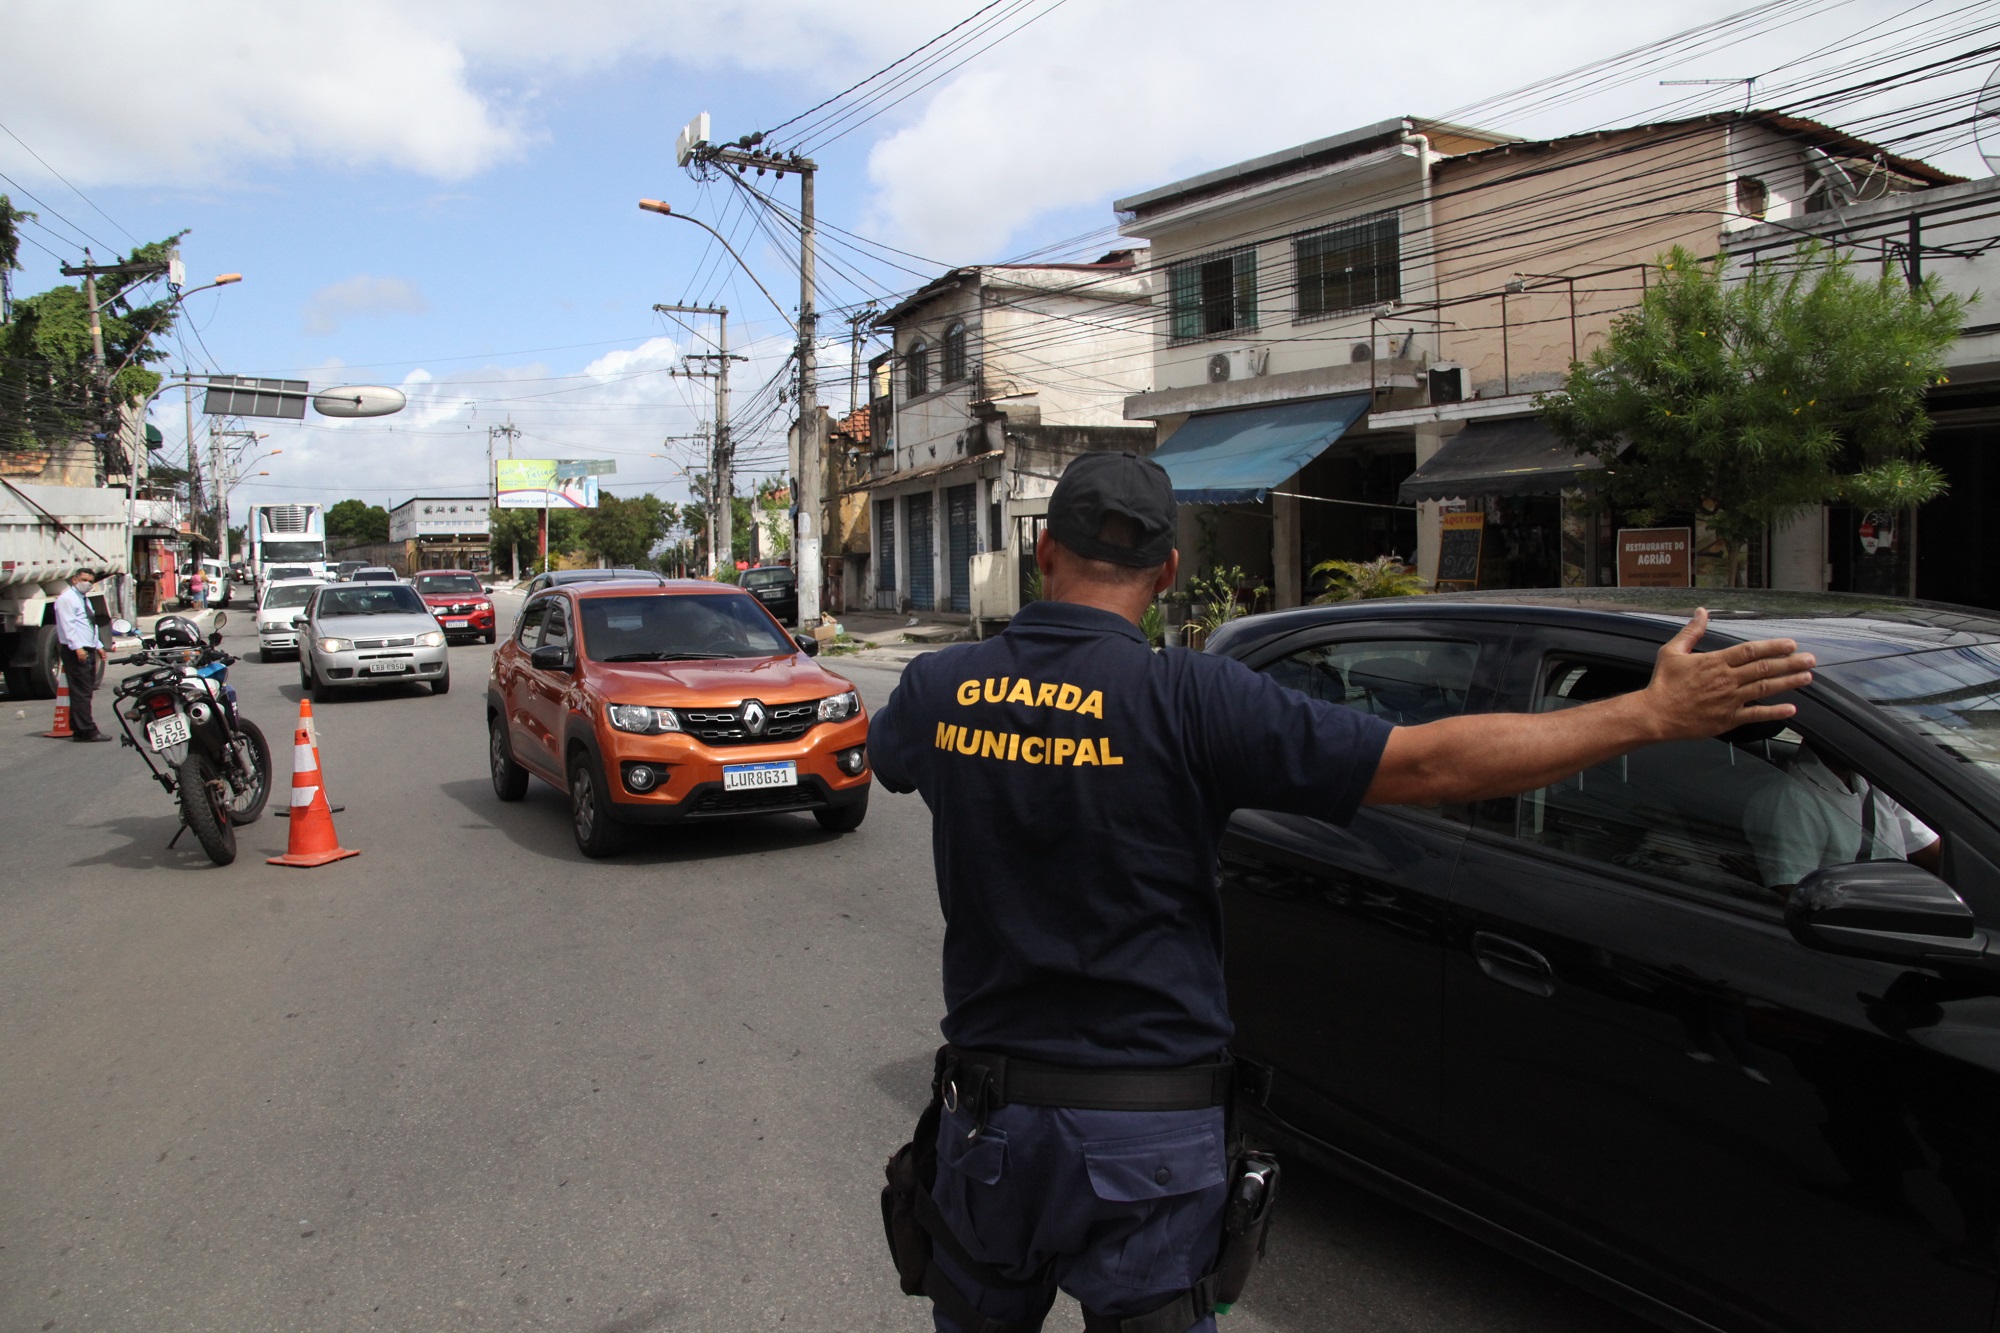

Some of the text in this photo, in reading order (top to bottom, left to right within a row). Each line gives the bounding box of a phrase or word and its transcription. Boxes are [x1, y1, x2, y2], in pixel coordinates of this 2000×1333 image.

[1443, 516, 1463, 525] AQUI
[1625, 541, 1684, 552] RESTAURANTE DO
[1637, 551, 1671, 566] AGRIÃO
[957, 677, 1103, 719] GUARDA
[156, 729, 187, 748] 9425
[935, 721, 1123, 766] MUNICIPAL
[730, 769, 789, 787] LUR8G31
